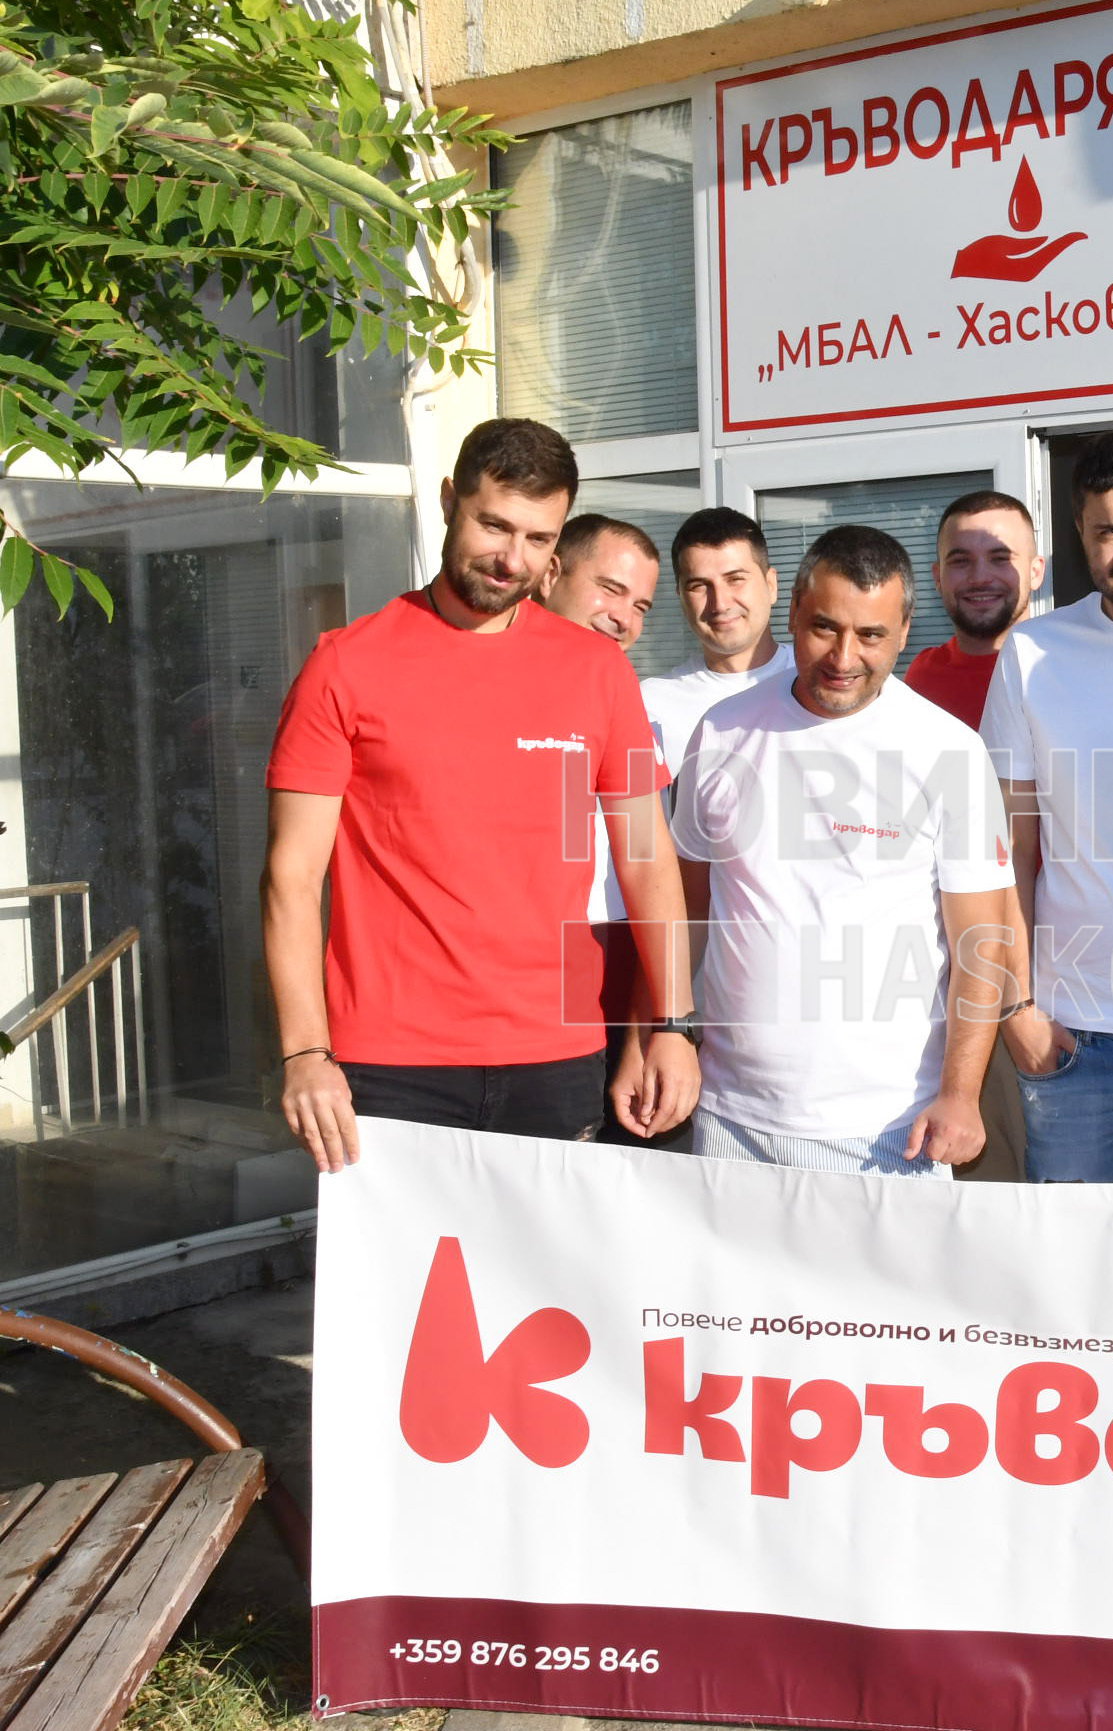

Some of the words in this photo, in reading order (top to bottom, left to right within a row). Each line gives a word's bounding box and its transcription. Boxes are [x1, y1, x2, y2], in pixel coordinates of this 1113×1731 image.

[642, 1308, 743, 1332] Повече
[750, 1315, 931, 1340] доброволно
[939, 1327, 956, 1342] и
[389, 1639, 462, 1664] +359
[470, 1640, 527, 1668] 876
[534, 1646, 591, 1671] 295
[599, 1648, 660, 1674] 846
